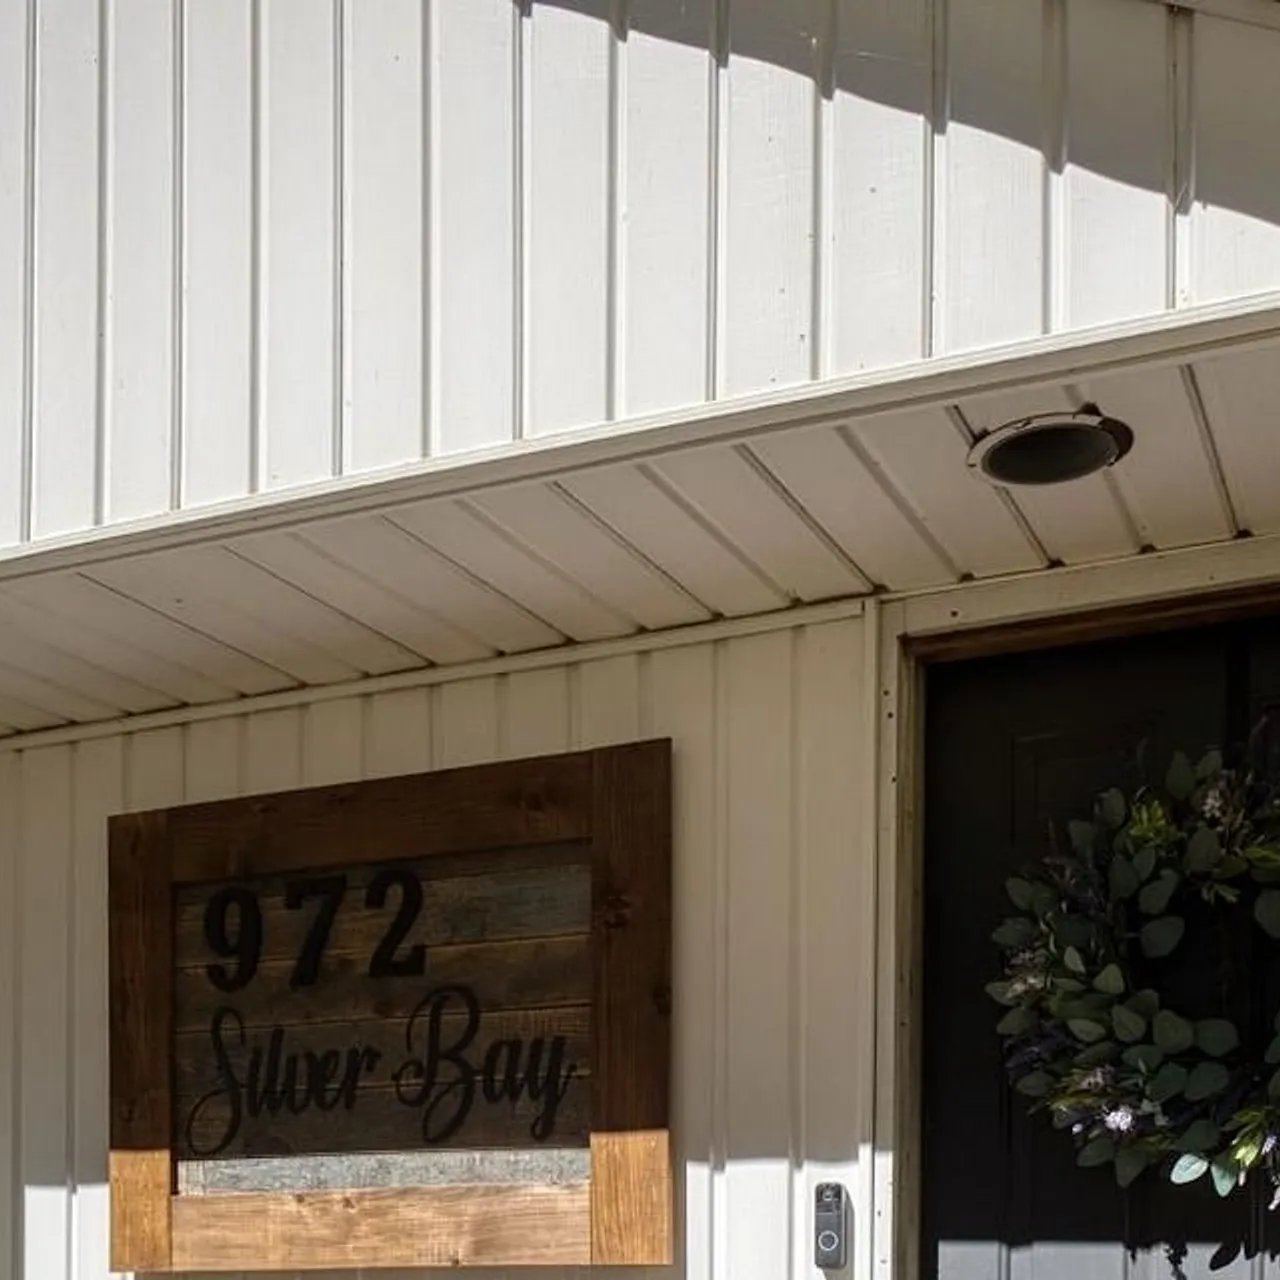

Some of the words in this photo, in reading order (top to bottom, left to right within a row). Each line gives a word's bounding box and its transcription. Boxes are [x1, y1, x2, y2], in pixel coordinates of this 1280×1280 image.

[203, 868, 428, 993] 972
[186, 1005, 381, 1156] Silver
[391, 985, 578, 1144] Bay
